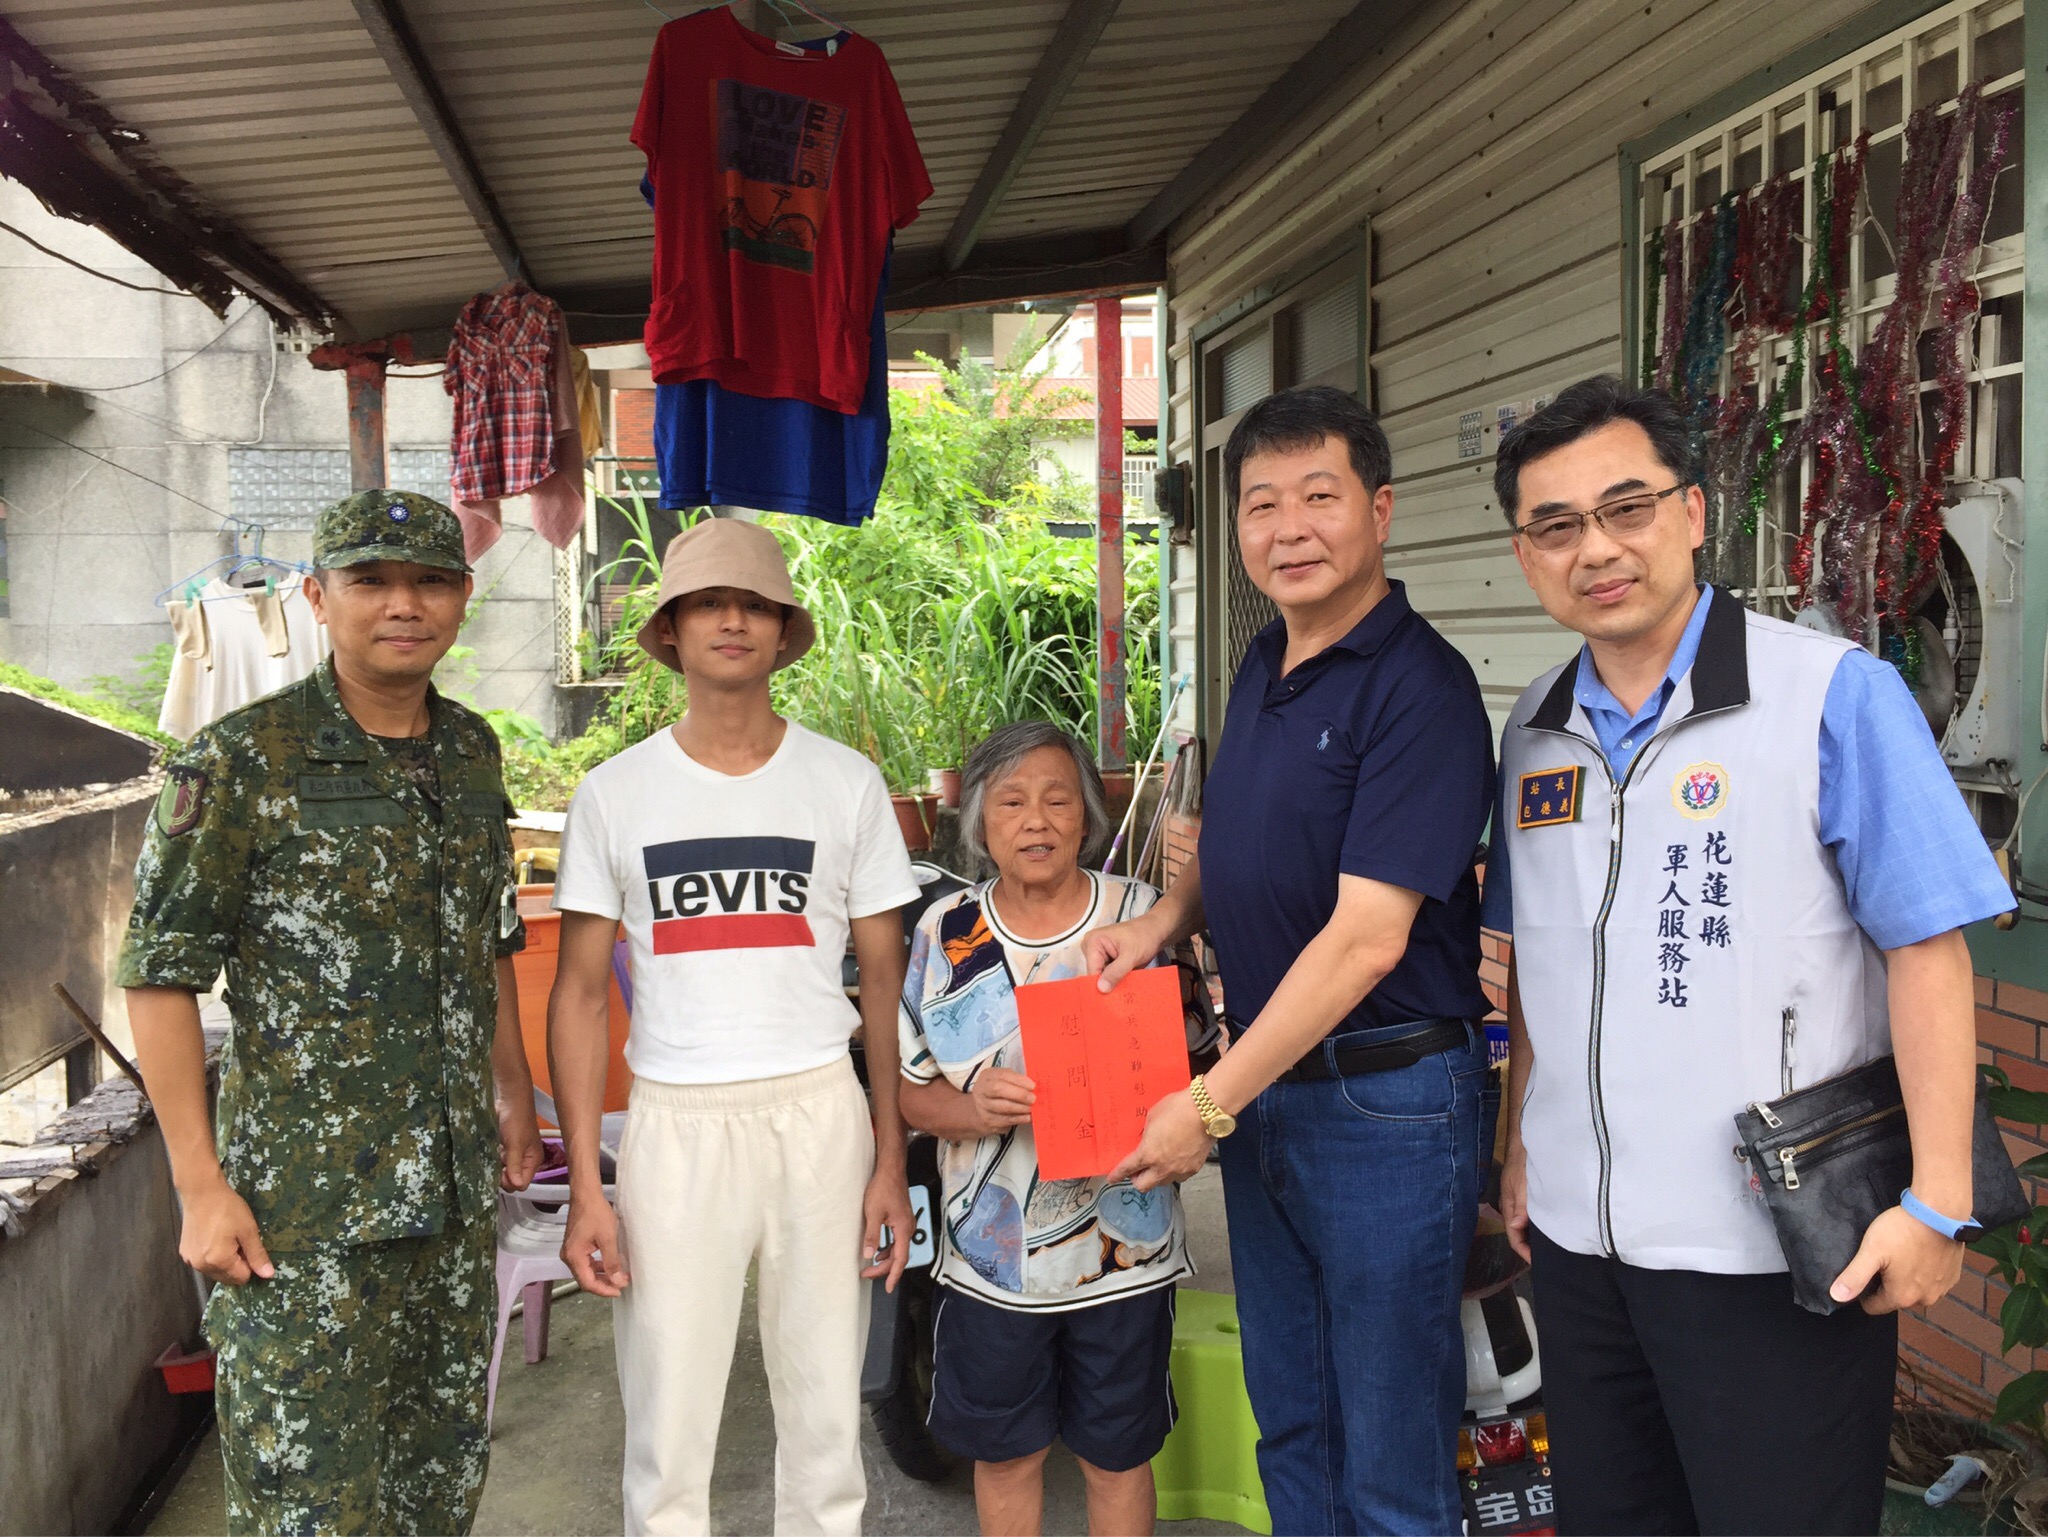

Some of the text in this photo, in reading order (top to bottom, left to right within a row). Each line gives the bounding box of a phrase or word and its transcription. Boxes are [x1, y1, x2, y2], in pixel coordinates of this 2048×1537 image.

[1657, 844, 1691, 1008] 軍人服務站
[1698, 831, 1732, 948] 花蓮縣
[1060, 1013, 1095, 1140] 慰問金
